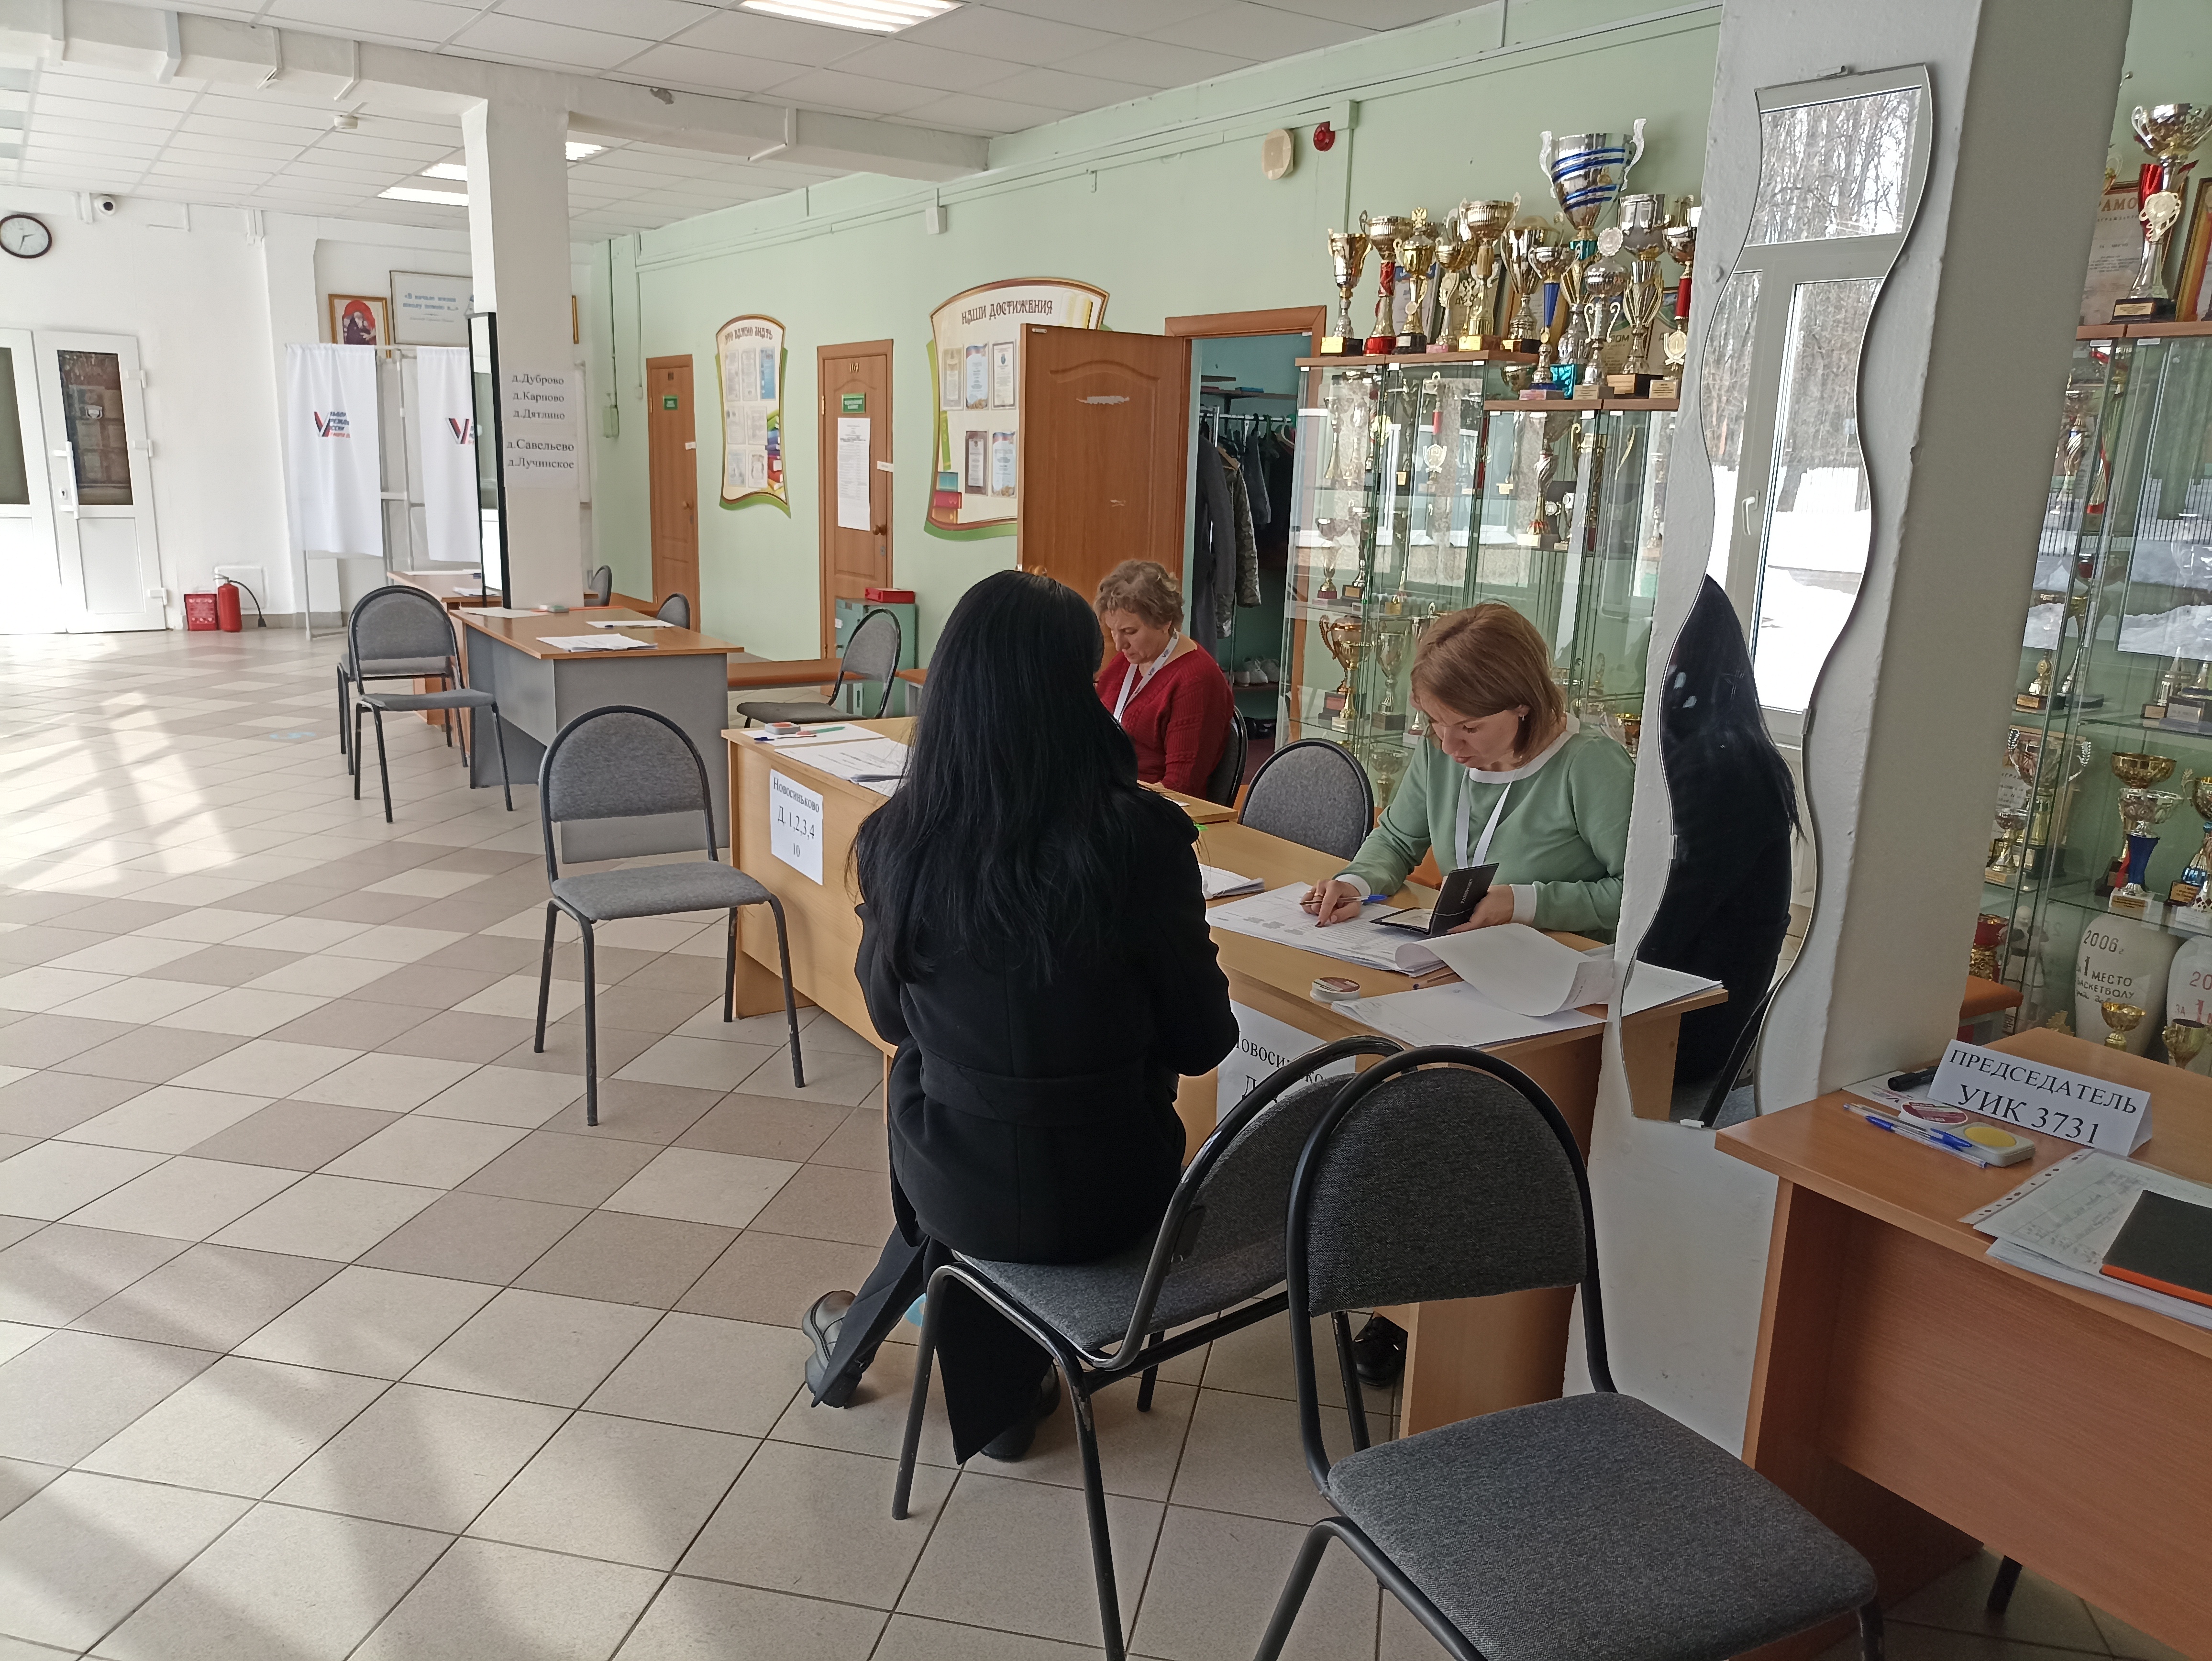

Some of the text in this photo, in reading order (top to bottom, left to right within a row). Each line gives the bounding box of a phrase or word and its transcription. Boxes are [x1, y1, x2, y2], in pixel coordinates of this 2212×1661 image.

[962, 299, 1052, 325] НАШИ ДОСТИЖЕНИЯ
[512, 374, 564, 386] д.Дуброво
[513, 391, 564, 403] д.Карпово
[507, 439, 574, 451] д.Савельево
[508, 457, 574, 469] д.Лучинское
[774, 777, 819, 813] Новосиньково
[778, 805, 814, 840] Д. 1,2,3,4
[794, 843, 800, 857] 10
[2084, 956, 2090, 976] 1
[2091, 971, 2132, 986] МЕСТО
[2175, 1004, 2186, 1018] ЗА
[1949, 1050, 2137, 1114] ПРЕДСЕДАТЕЛЬ
[1958, 1084, 2099, 1144] УИК 3731
